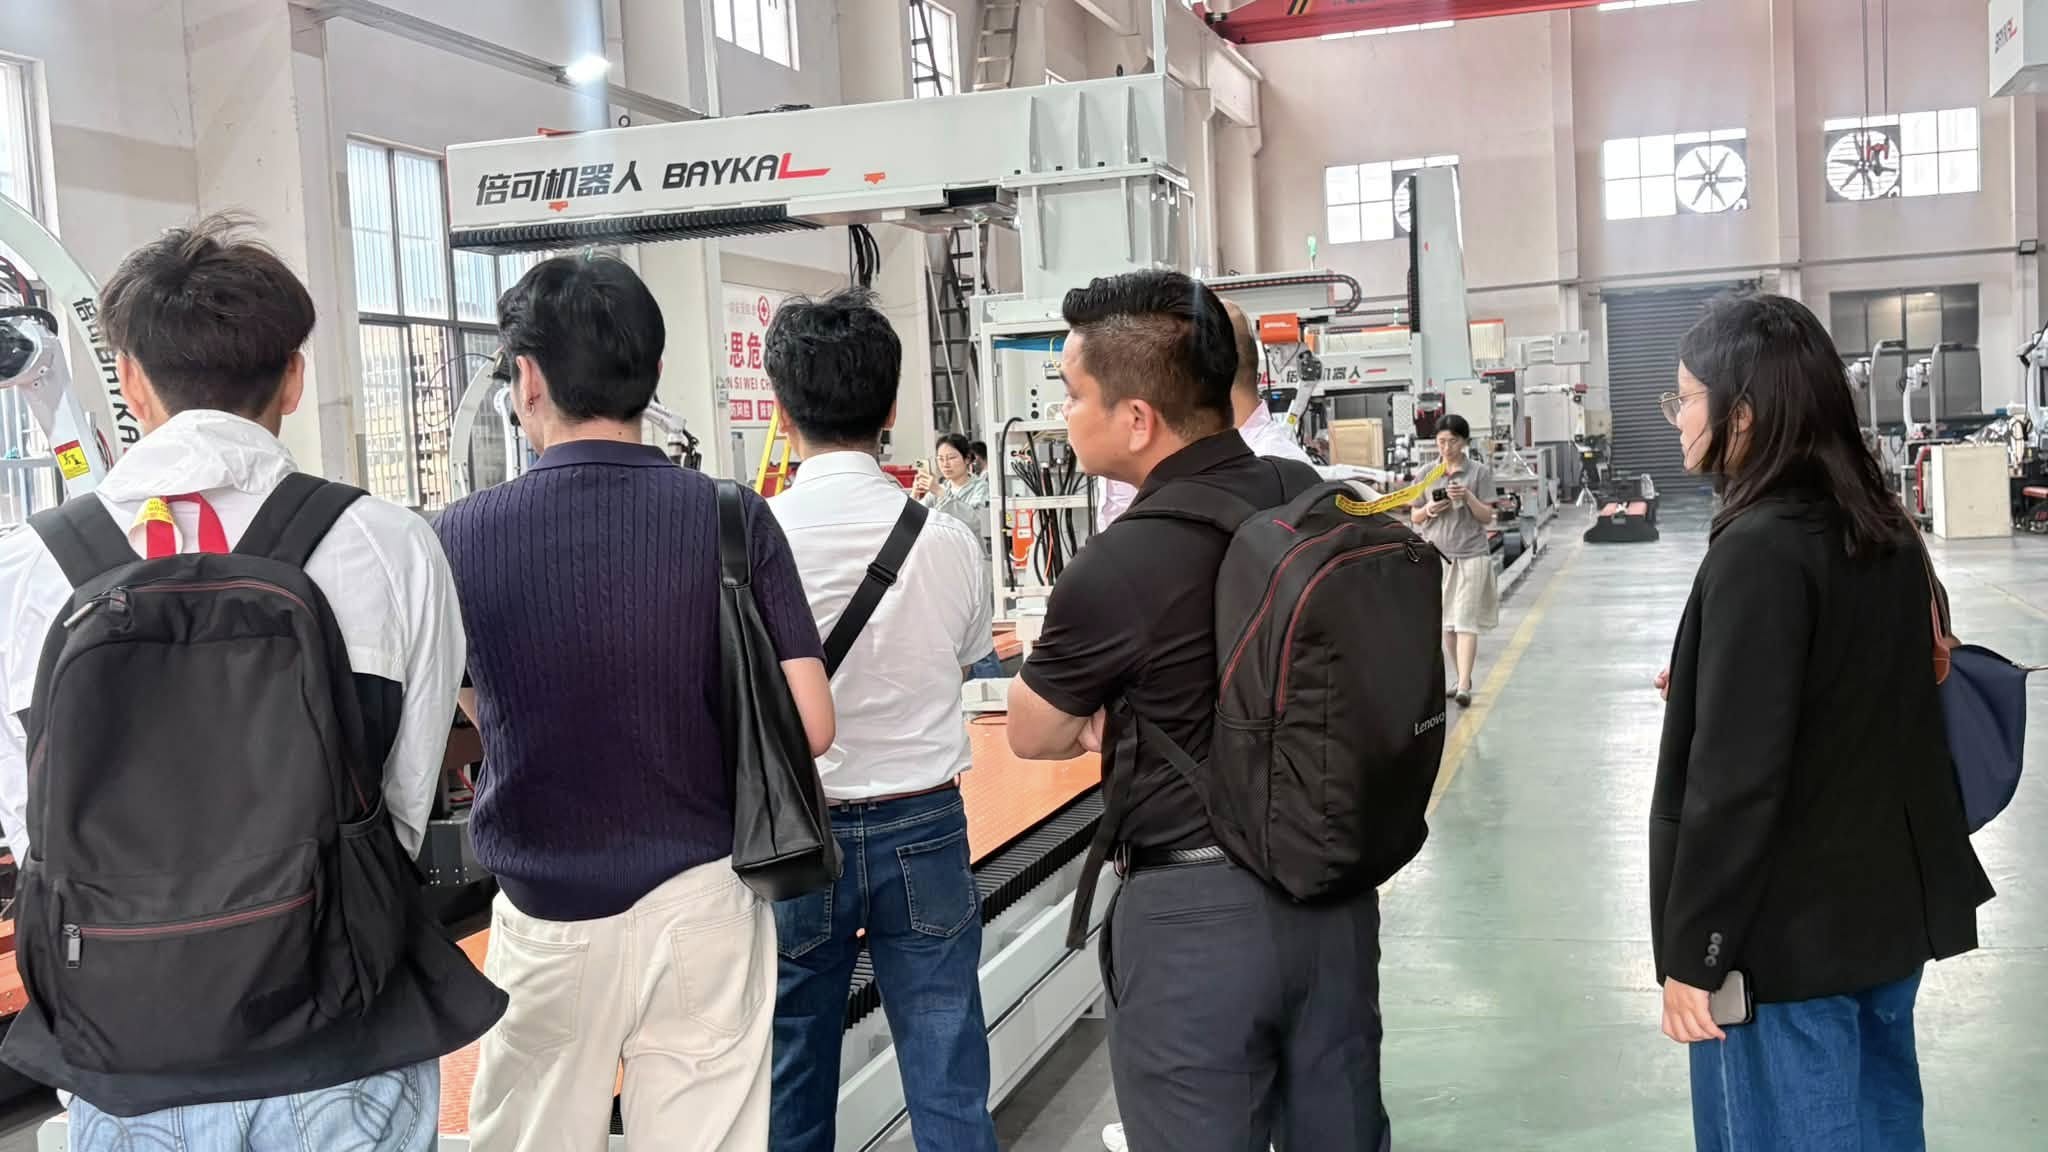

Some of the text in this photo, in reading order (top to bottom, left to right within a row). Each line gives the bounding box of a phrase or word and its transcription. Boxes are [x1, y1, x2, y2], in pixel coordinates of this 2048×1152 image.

[475, 152, 832, 206] 倍可机器人 BAYKAL
[95, 346, 141, 454] BAYKA
[1414, 711, 1445, 736] Lenovo
